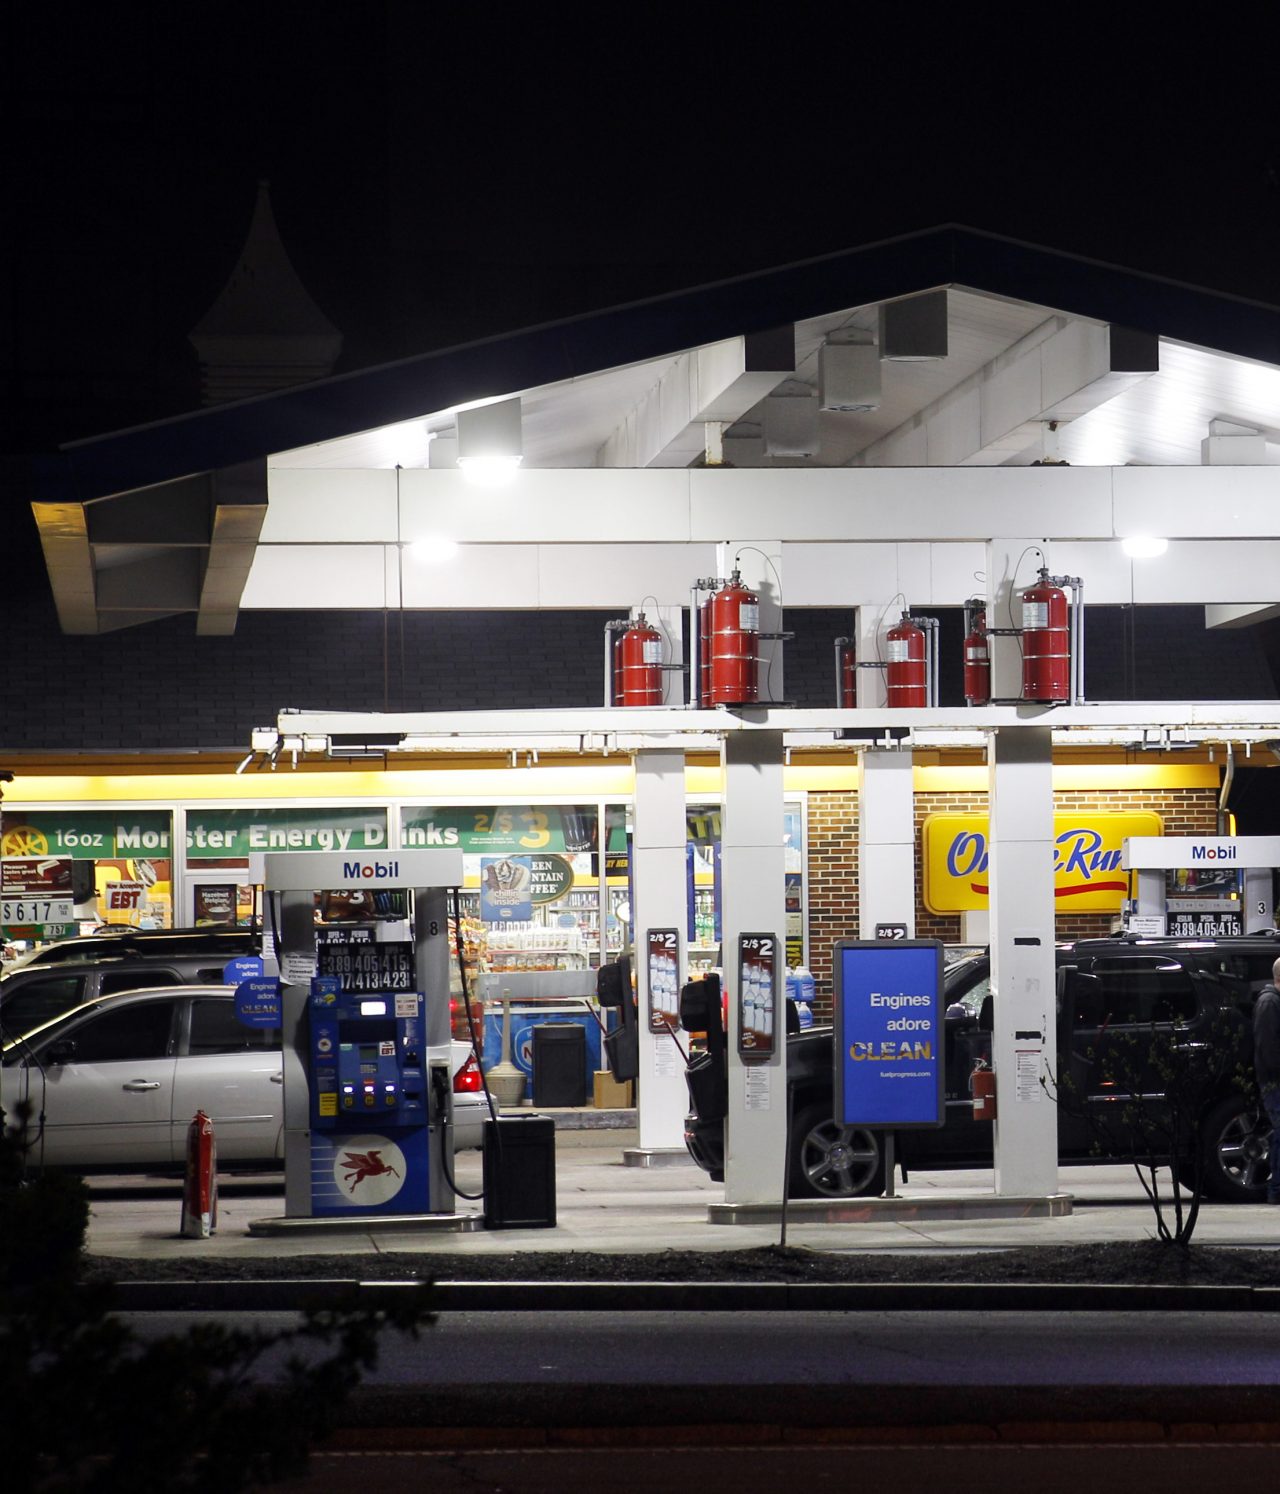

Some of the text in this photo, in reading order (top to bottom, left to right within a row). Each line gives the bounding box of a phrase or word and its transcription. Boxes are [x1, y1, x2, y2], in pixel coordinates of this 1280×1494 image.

[55, 829, 103, 847] 16oz
[250, 824, 352, 850] Energy
[364, 822, 459, 846] Dinks
[1192, 846, 1236, 859] Mobil
[343, 862, 399, 879] Mobil
[532, 861, 552, 870] EEN
[531, 872, 564, 881] NTAIN
[530, 884, 557, 893] FFEE
[111, 891, 141, 909] EBT
[1258, 902, 1266, 914] 3
[430, 921, 438, 936] 8
[383, 971, 407, 987] 4.23
[250, 983, 276, 991] Engines
[870, 992, 931, 1010] Engines
[886, 1017, 931, 1031] adore
[849, 1041, 936, 1061] CLEAN.
